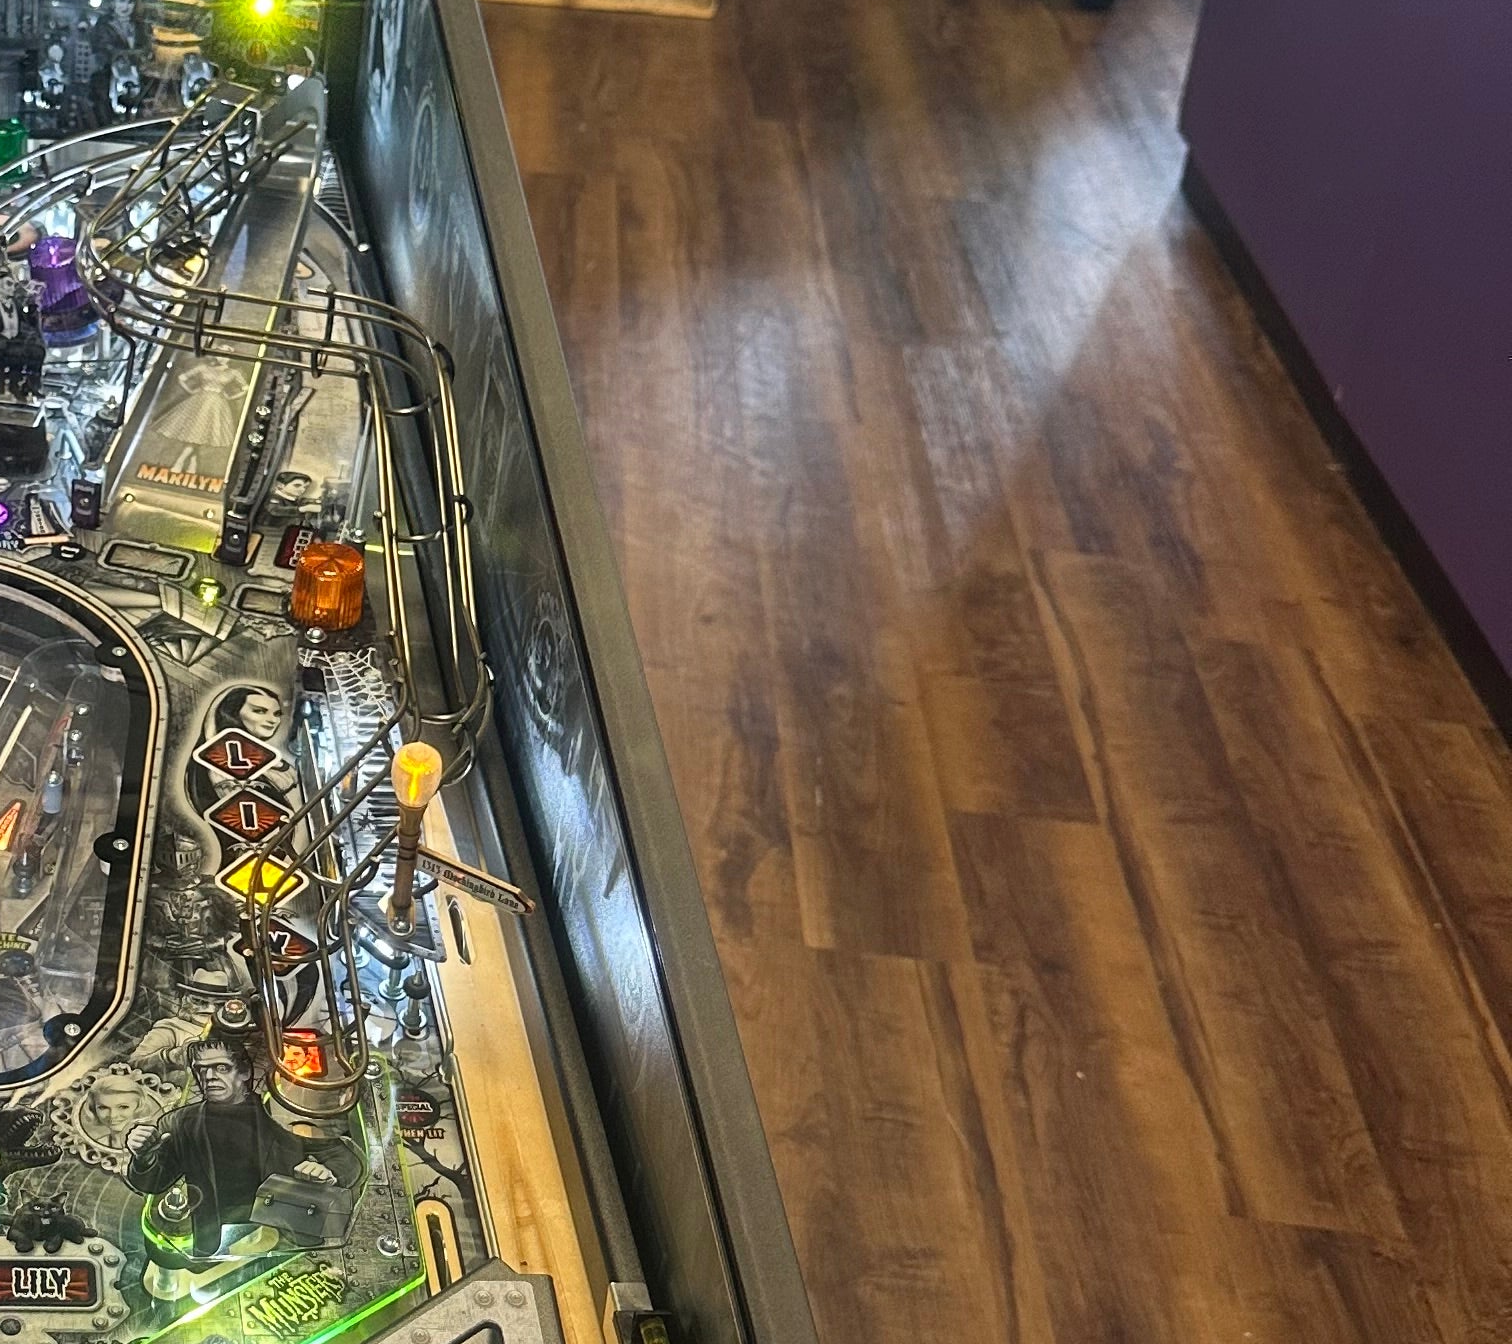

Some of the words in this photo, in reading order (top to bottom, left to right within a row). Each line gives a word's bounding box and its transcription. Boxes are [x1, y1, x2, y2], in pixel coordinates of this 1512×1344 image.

[137, 464, 224, 494] MARILYN
[225, 741, 252, 769] L
[422, 859, 441, 874] 1313
[442, 869, 497, 899] Mockingbird
[497, 892, 520, 909] Lane
[427, 1129, 445, 1139] LIT
[11, 1266, 71, 1301] LILY
[267, 1271, 294, 1289] THE
[247, 1263, 345, 1340] MUNSTERS
